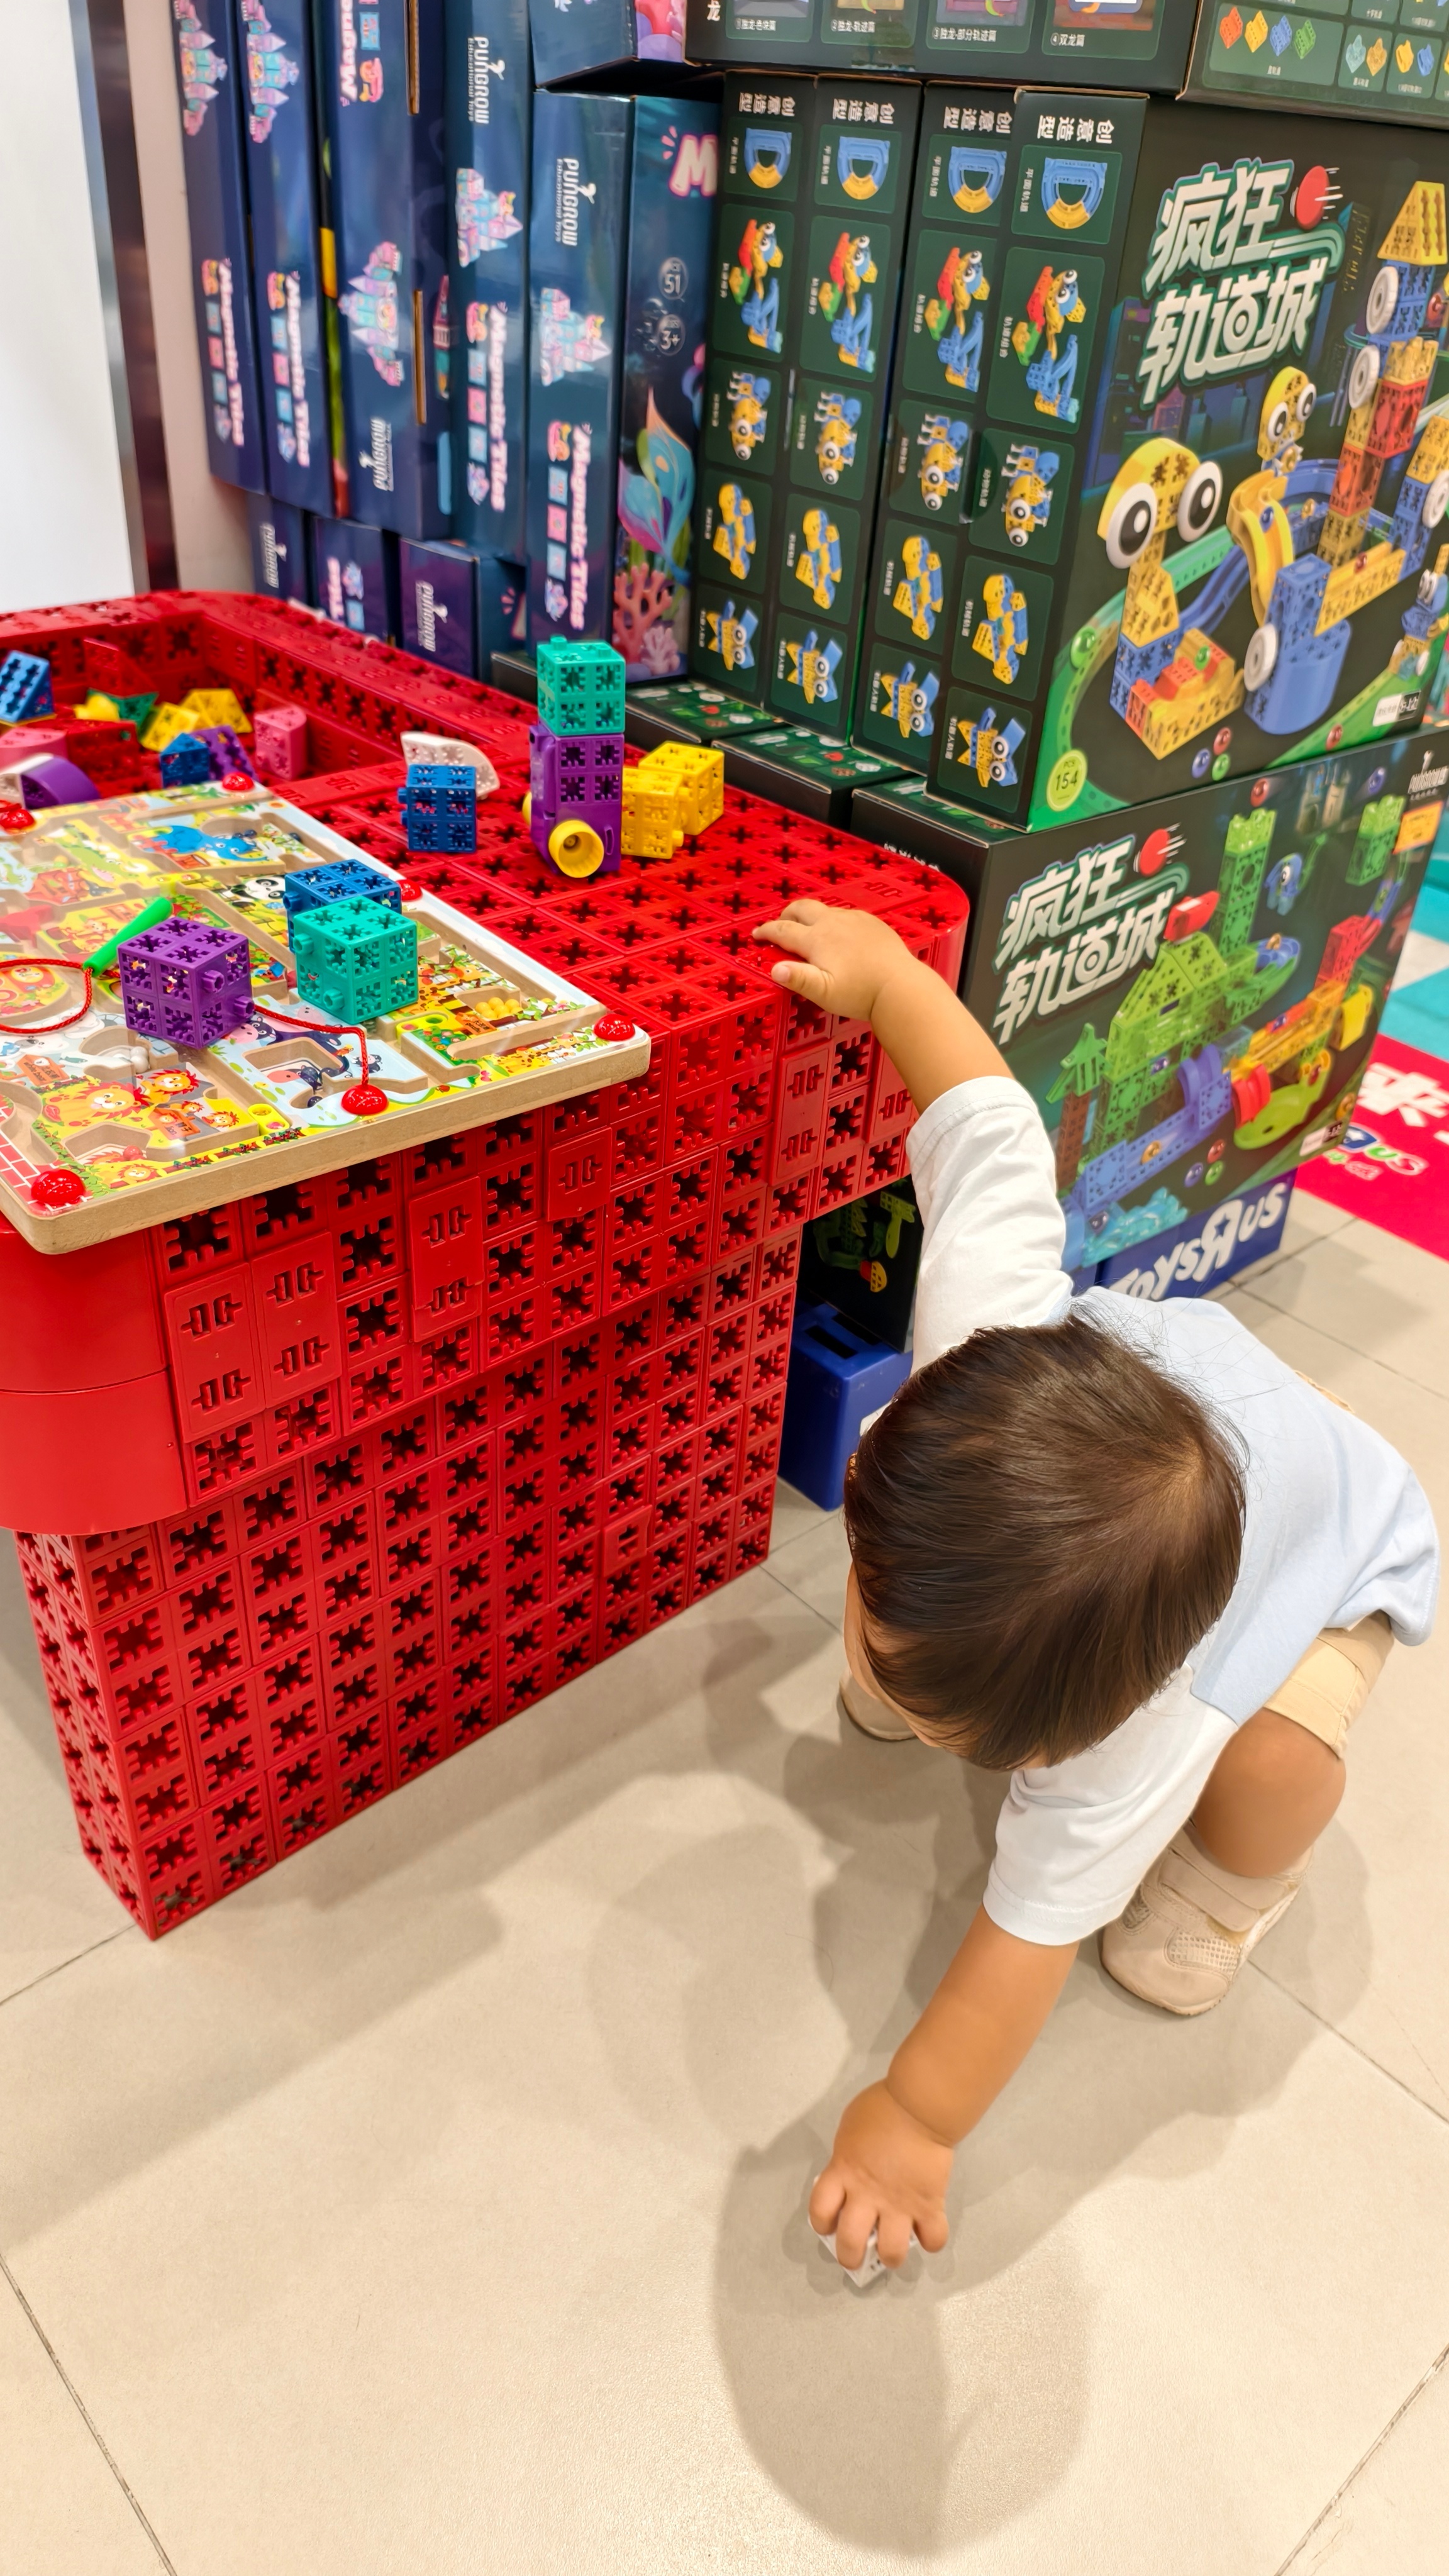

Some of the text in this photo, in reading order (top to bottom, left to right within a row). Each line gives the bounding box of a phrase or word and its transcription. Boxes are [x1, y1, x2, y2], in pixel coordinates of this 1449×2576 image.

[738, 91, 796, 118] 创意造型
[832, 97, 895, 126] 创意造型
[943, 106, 1013, 135] 创意造型
[1036, 114, 1115, 145] 创意造型
[1143, 163, 1291, 293] 疯狂
[663, 274, 681, 295] 51
[1138, 255, 1330, 406] 轨道城
[487, 304, 508, 513] Magnetic Tiles
[569, 425, 591, 630] Magnetic Tiles
[1055, 770, 1079, 791] 154
[994, 837, 1135, 969] 疯狂
[992, 886, 1176, 1046] 轨道城
[164, 1126, 177, 1135] lion
